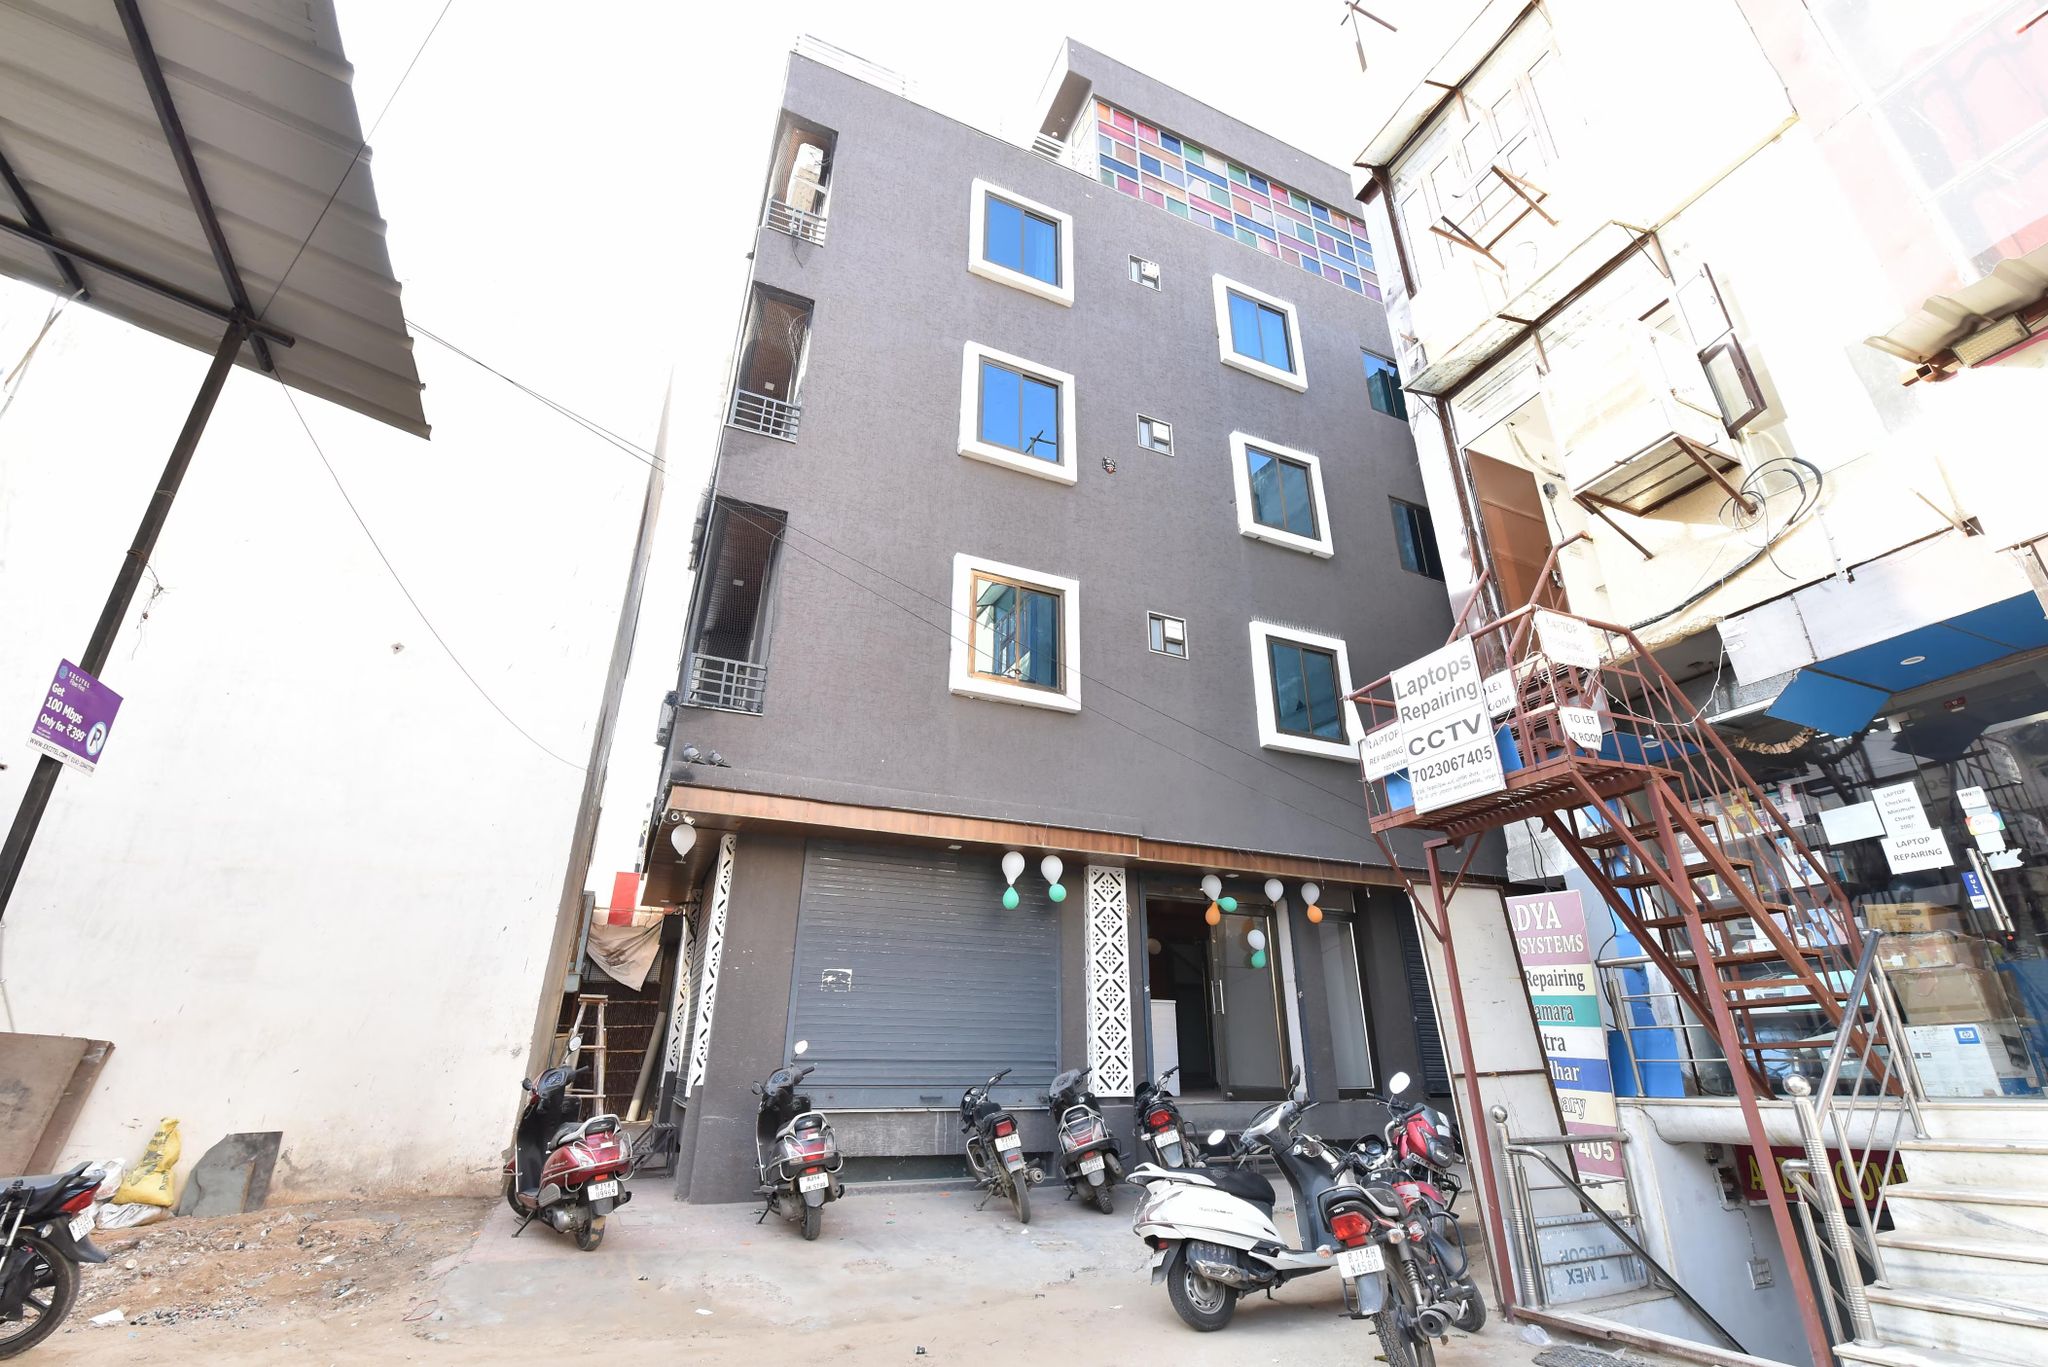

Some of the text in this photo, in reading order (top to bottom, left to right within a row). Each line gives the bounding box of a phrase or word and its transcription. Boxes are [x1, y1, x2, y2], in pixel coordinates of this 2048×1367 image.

[52, 683, 65, 697] Get
[1395, 654, 1471, 700] Laptops
[46, 696, 83, 724] 100 Mbps
[1400, 681, 1478, 724] Repairing
[40, 713, 56, 729] Only
[55, 721, 66, 733] for
[1568, 713, 1595, 725] TO LET
[1409, 713, 1481, 756] CCTV
[1412, 745, 1492, 782] 7023067405
[1893, 848, 1943, 862] REPAIRING
[1895, 836, 1930, 849] LAPTOP
[1509, 900, 1562, 932] DYA
[1525, 968, 1586, 992] Repairing
